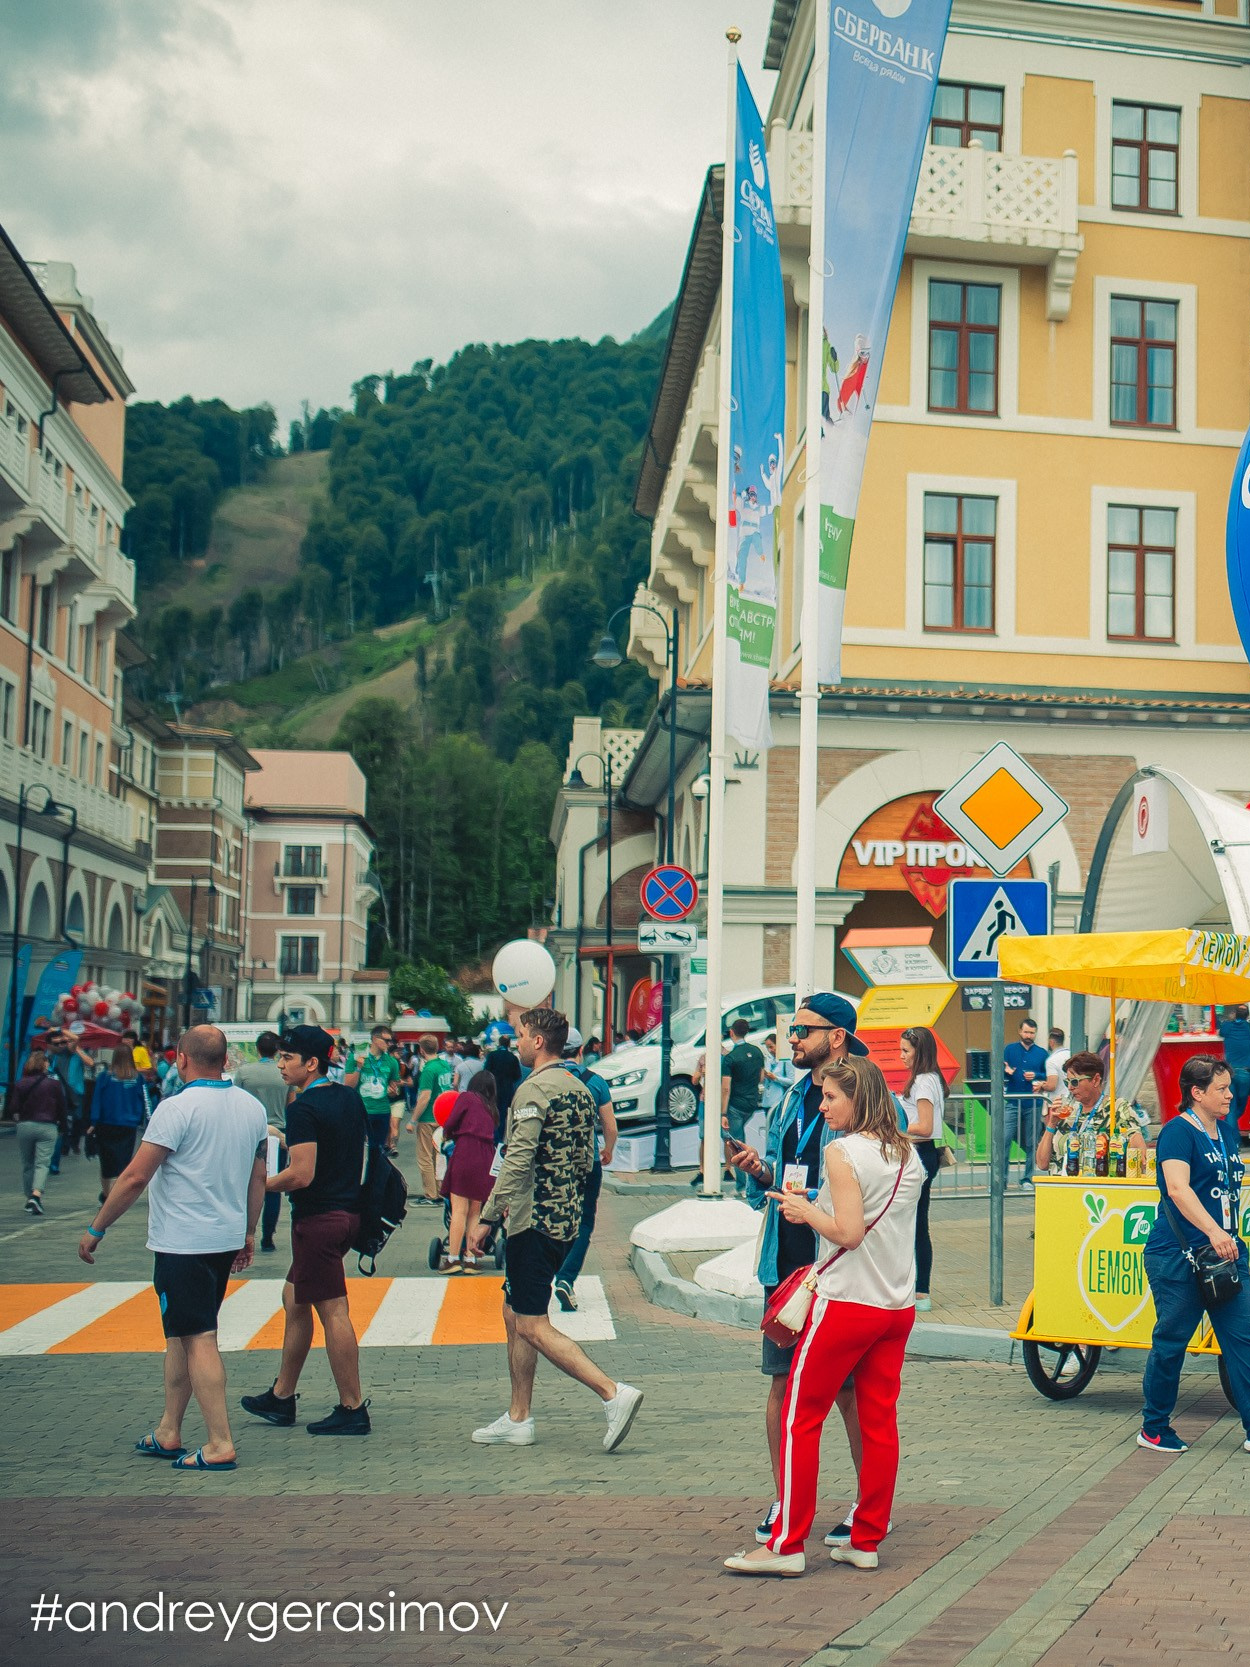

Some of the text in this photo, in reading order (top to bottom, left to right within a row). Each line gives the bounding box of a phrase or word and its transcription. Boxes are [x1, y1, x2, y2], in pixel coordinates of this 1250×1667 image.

[834, 6, 935, 75] СБЕРБАНК
[852, 840, 986, 868] VIP ПРОК
